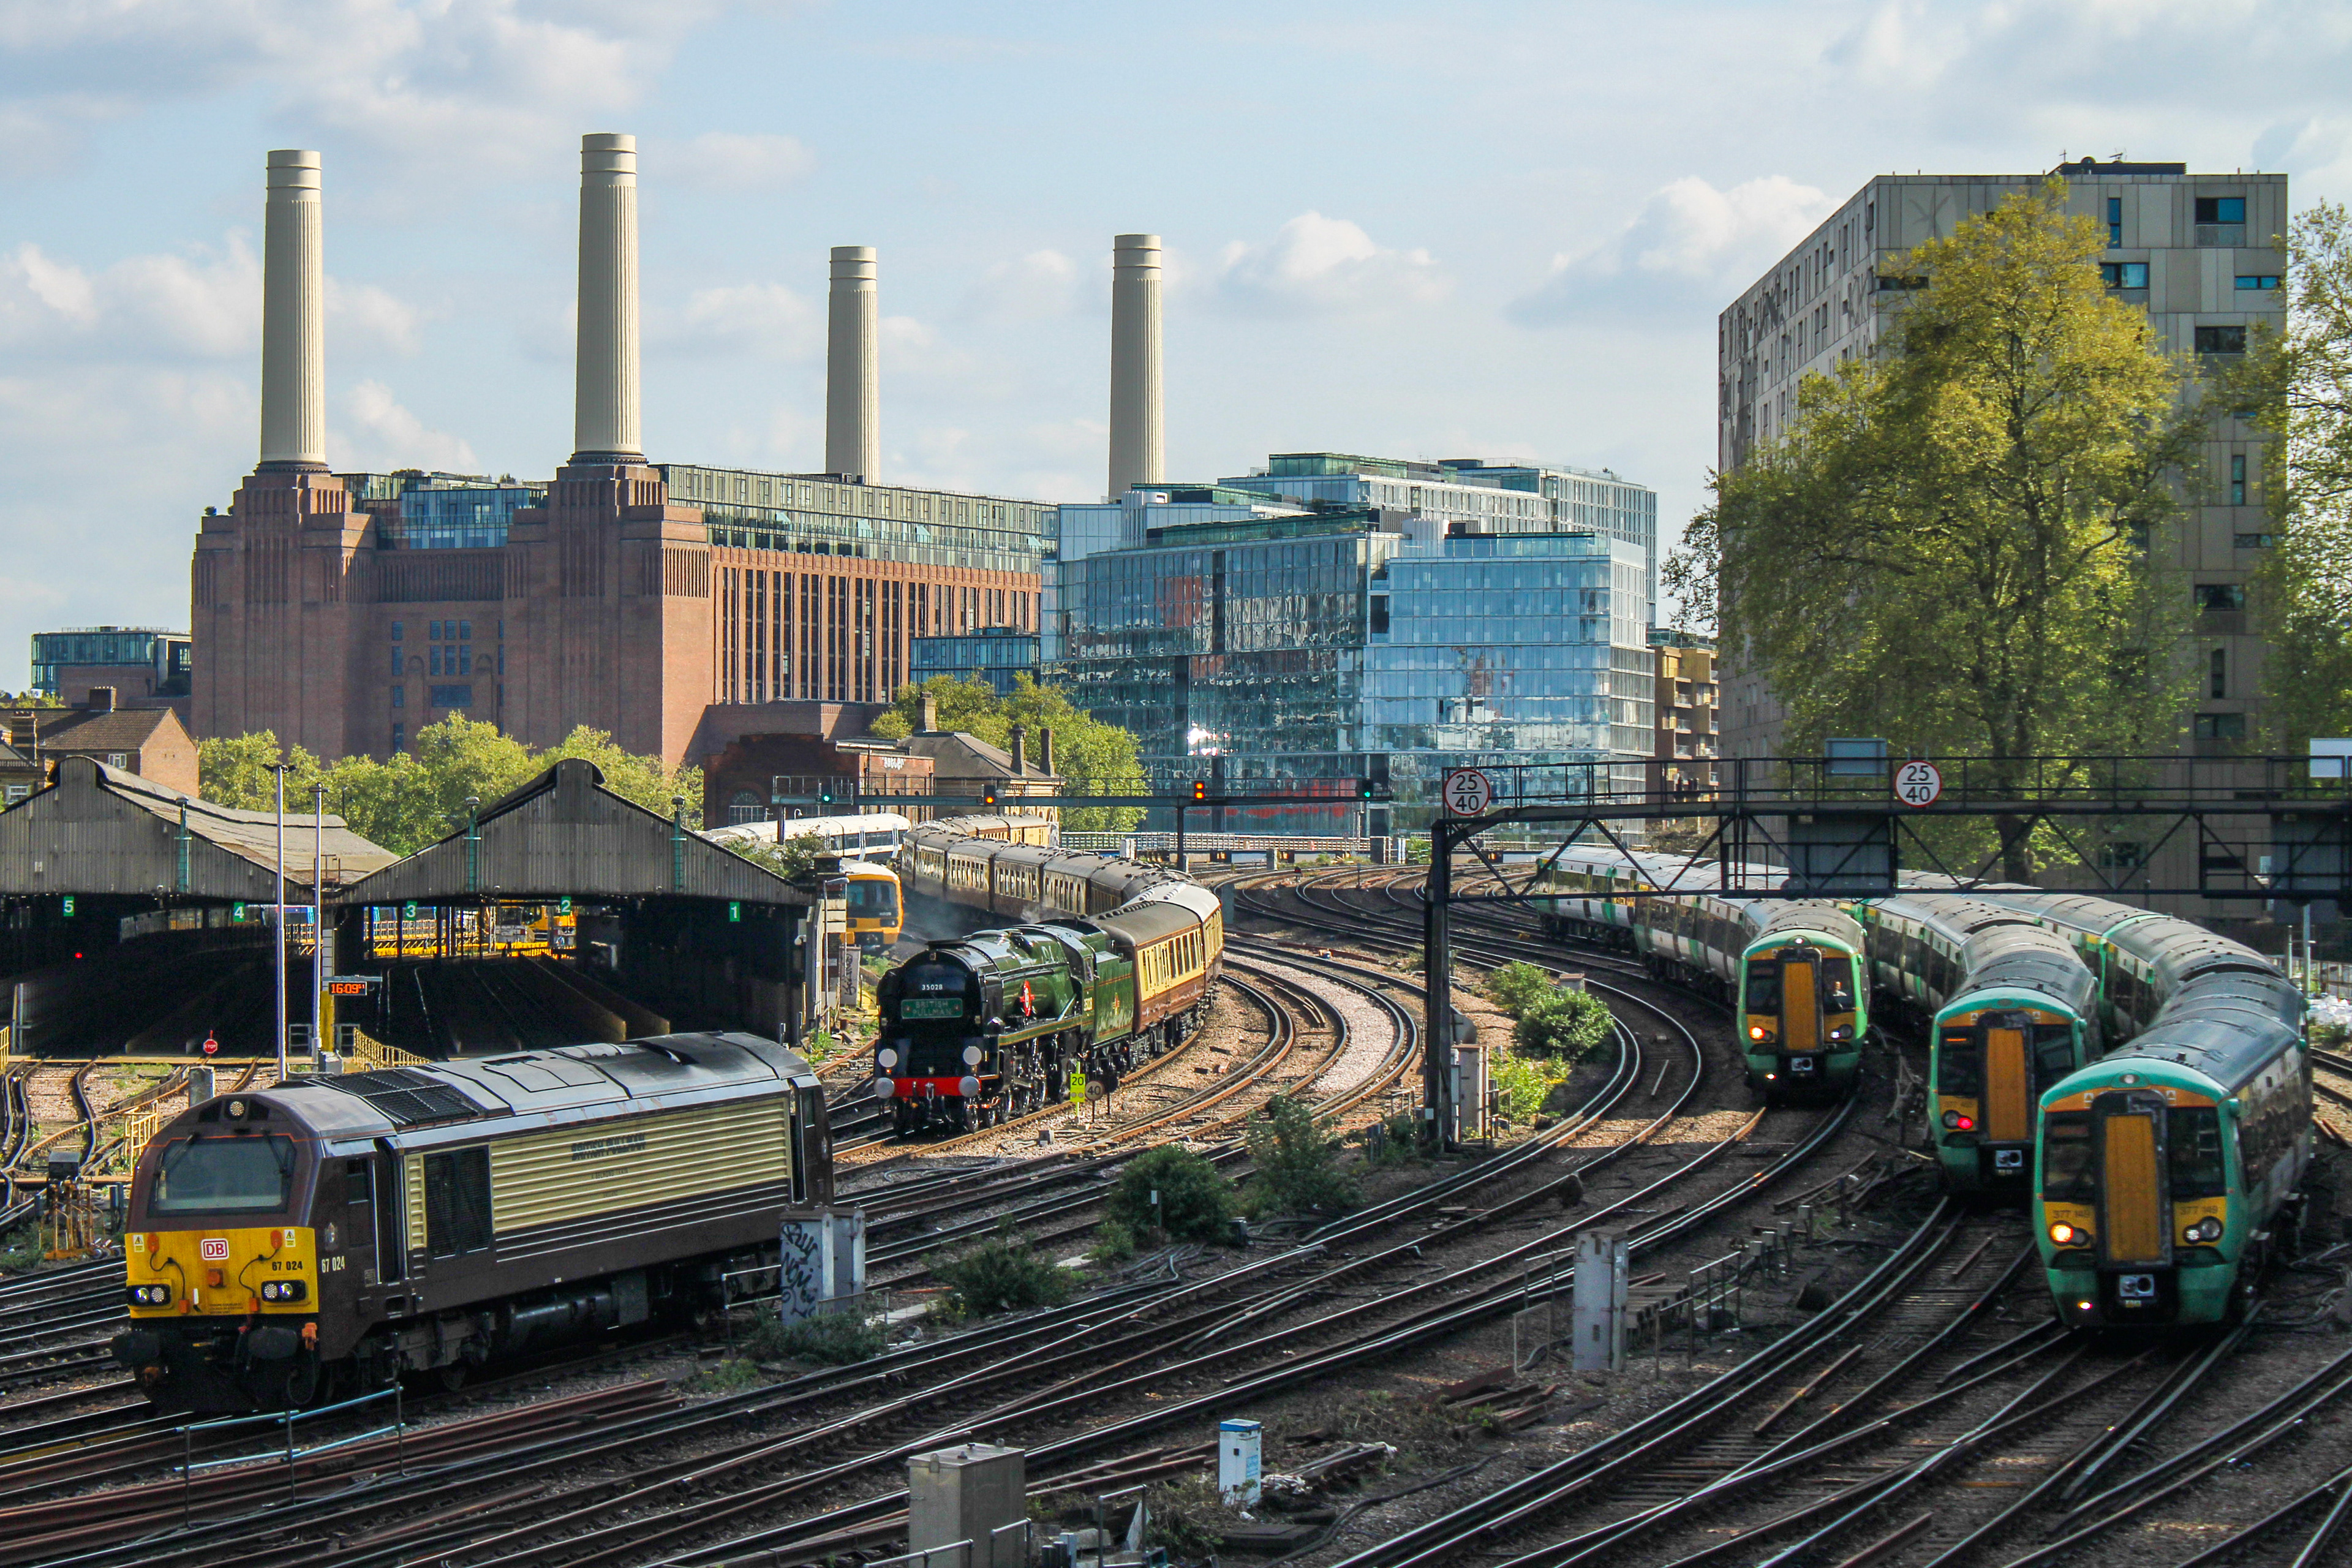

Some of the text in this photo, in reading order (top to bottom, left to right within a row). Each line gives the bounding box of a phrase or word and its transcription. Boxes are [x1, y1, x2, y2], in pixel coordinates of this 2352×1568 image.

[1907, 765, 1929, 782] 25
[1456, 774, 1477, 790] 25
[1906, 786, 1931, 802] 40
[1455, 795, 1479, 811] 40
[64, 900, 74, 913] 5
[234, 906, 244, 919] 4
[406, 905, 416, 918] 3
[561, 900, 571, 912] 2
[730, 905, 737, 918] 1
[331, 983, 359, 994] 16:09
[913, 1008, 952, 1017] PULLMAN
[1072, 1077, 1084, 1086] 20
[1087, 1085, 1101, 1095] 40
[206, 1243, 225, 1256] DB
[272, 1261, 303, 1271] 67 024
[322, 1256, 345, 1273] 67 024
